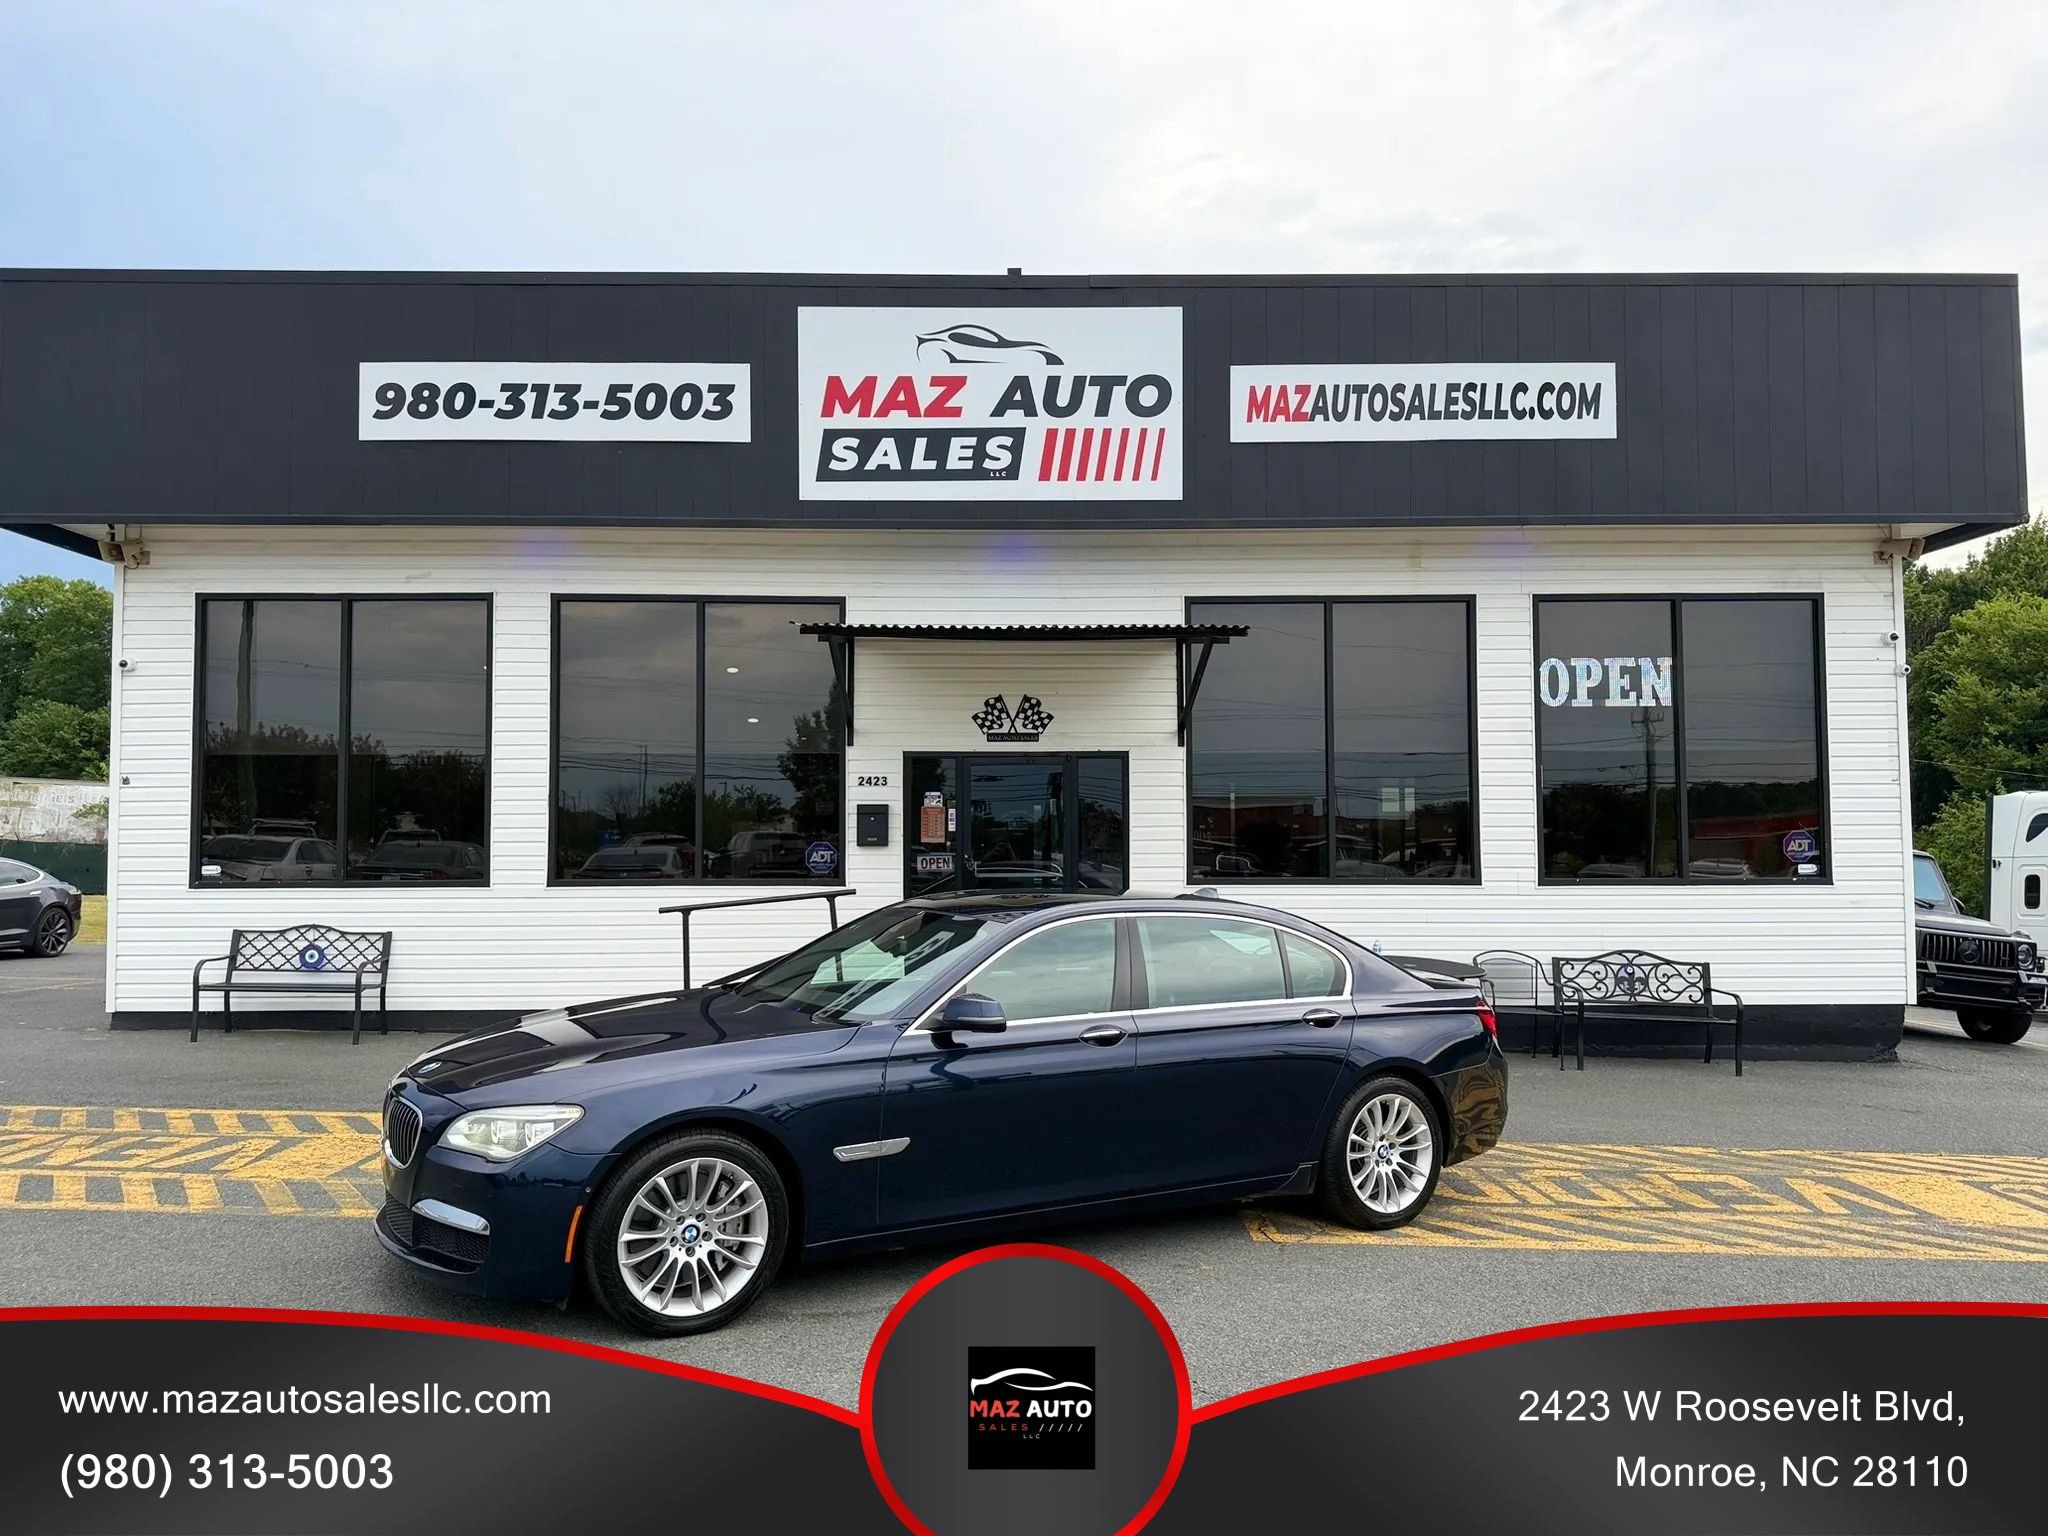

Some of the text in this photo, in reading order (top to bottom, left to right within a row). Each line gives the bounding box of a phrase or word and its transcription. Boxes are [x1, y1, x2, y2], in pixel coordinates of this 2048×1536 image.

[372, 381, 736, 421] 980-313-5003
[820, 373, 1173, 419] MAZ AUTO
[1246, 381, 1602, 423] MAZAUTOSALESLLC.COM
[828, 435, 1014, 471] SALES
[1539, 656, 1673, 708] OPEN
[857, 775, 889, 787] 2423
[809, 850, 834, 863] ADT
[920, 857, 951, 869] OPEN
[1786, 839, 1812, 852] ADT
